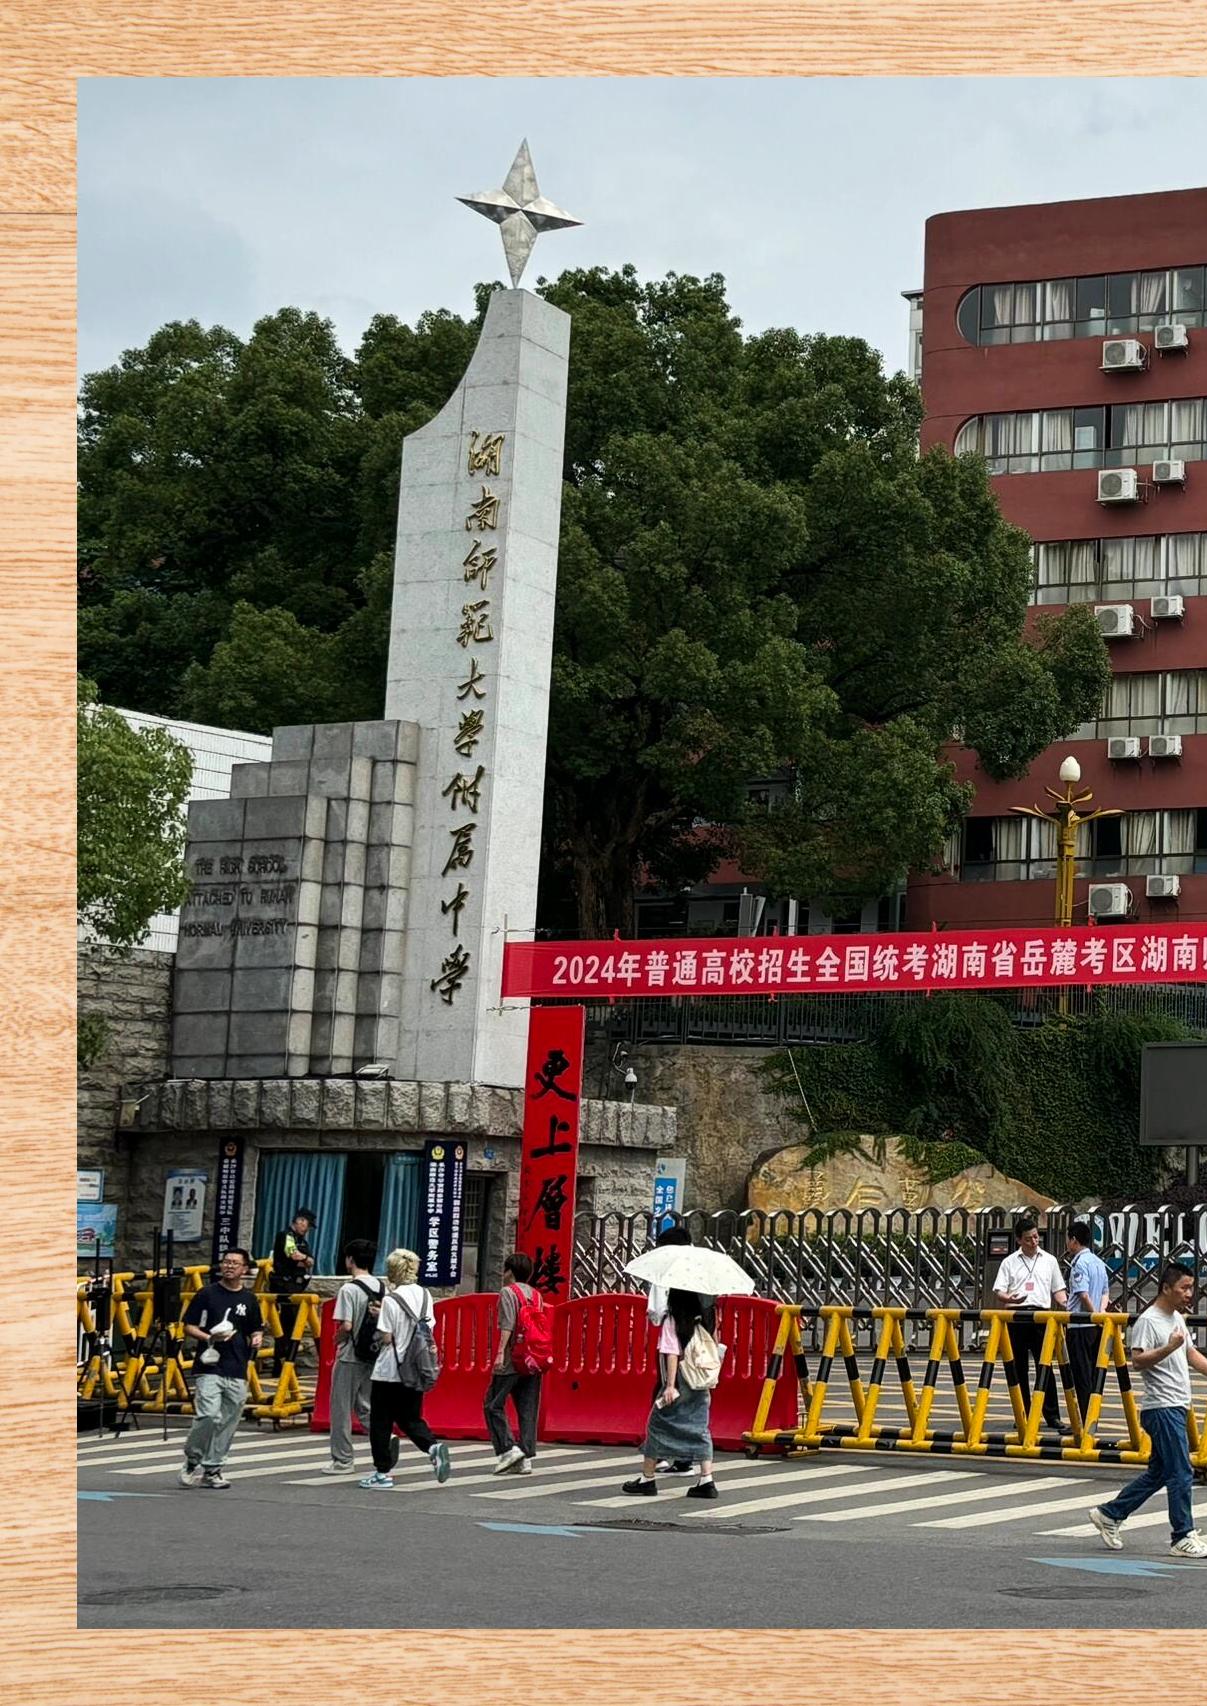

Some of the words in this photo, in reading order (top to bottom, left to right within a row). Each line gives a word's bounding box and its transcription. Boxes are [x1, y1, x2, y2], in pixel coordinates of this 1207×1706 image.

[195, 858, 213, 875] THE
[426, 1216, 440, 1272] 学区警务室
